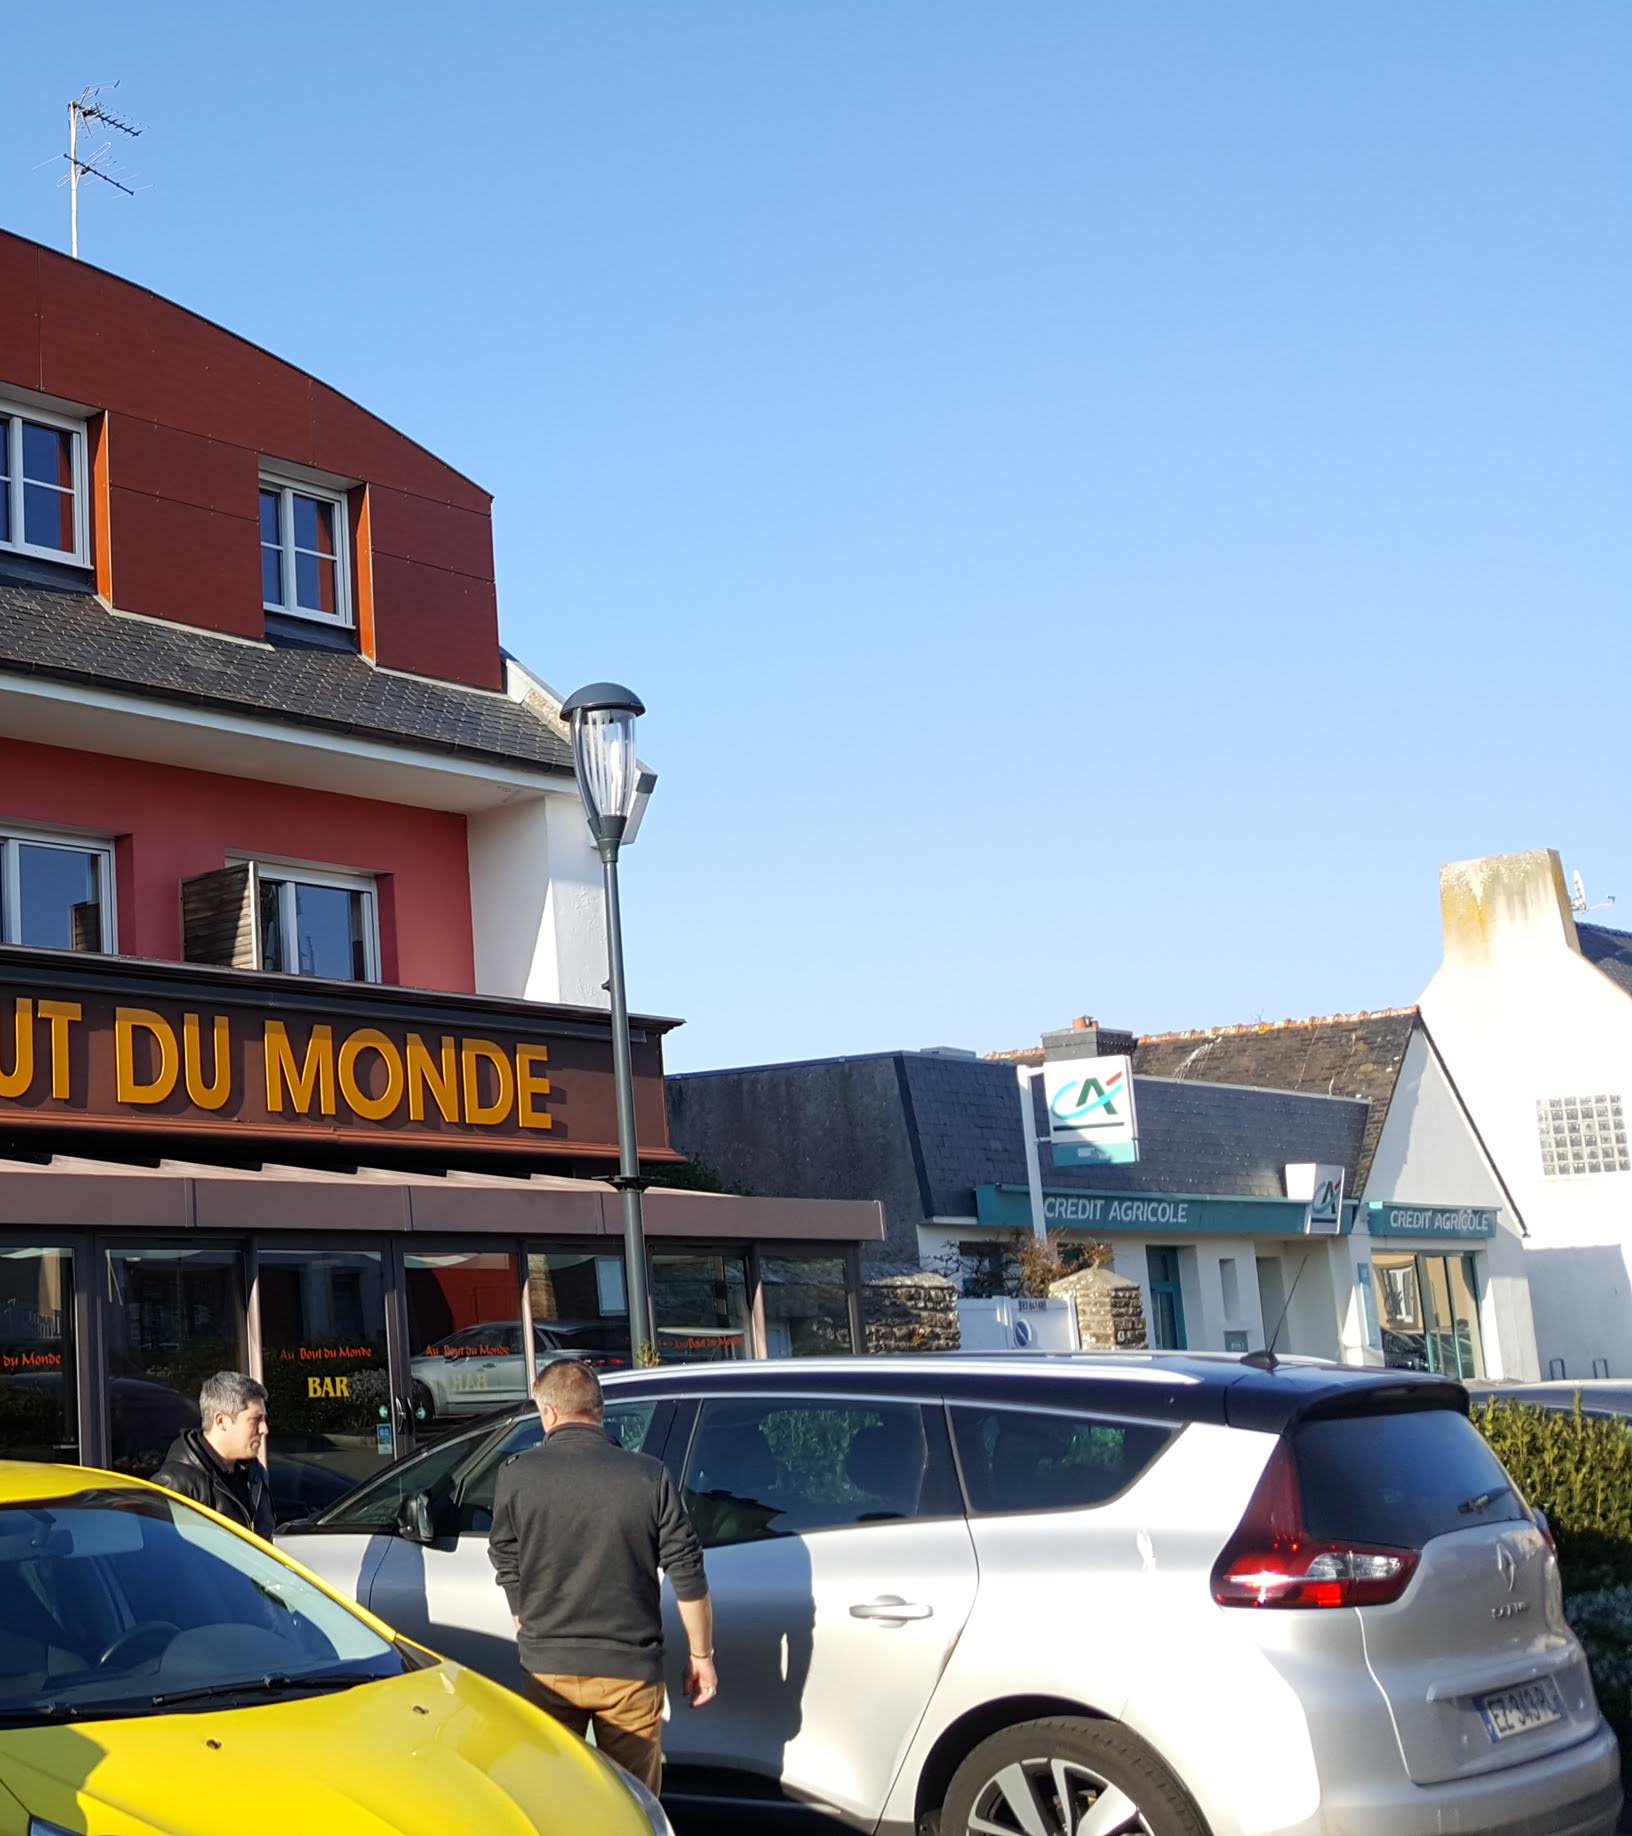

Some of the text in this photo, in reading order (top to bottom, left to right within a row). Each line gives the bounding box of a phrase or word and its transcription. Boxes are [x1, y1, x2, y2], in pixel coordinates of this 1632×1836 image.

[114, 1007, 232, 1111] DU
[264, 1019, 553, 1130] MONDE
[1108, 1201, 1189, 1223] AGRICOLE
[1434, 1210, 1489, 1230] AGRICOLE
[3, 1354, 19, 1367] du
[22, 1351, 62, 1366] Monde
[279, 1348, 295, 1360] Au
[299, 1347, 322, 1360] Bout
[339, 1346, 373, 1358] Monde
[307, 1376, 350, 1398] BAR
